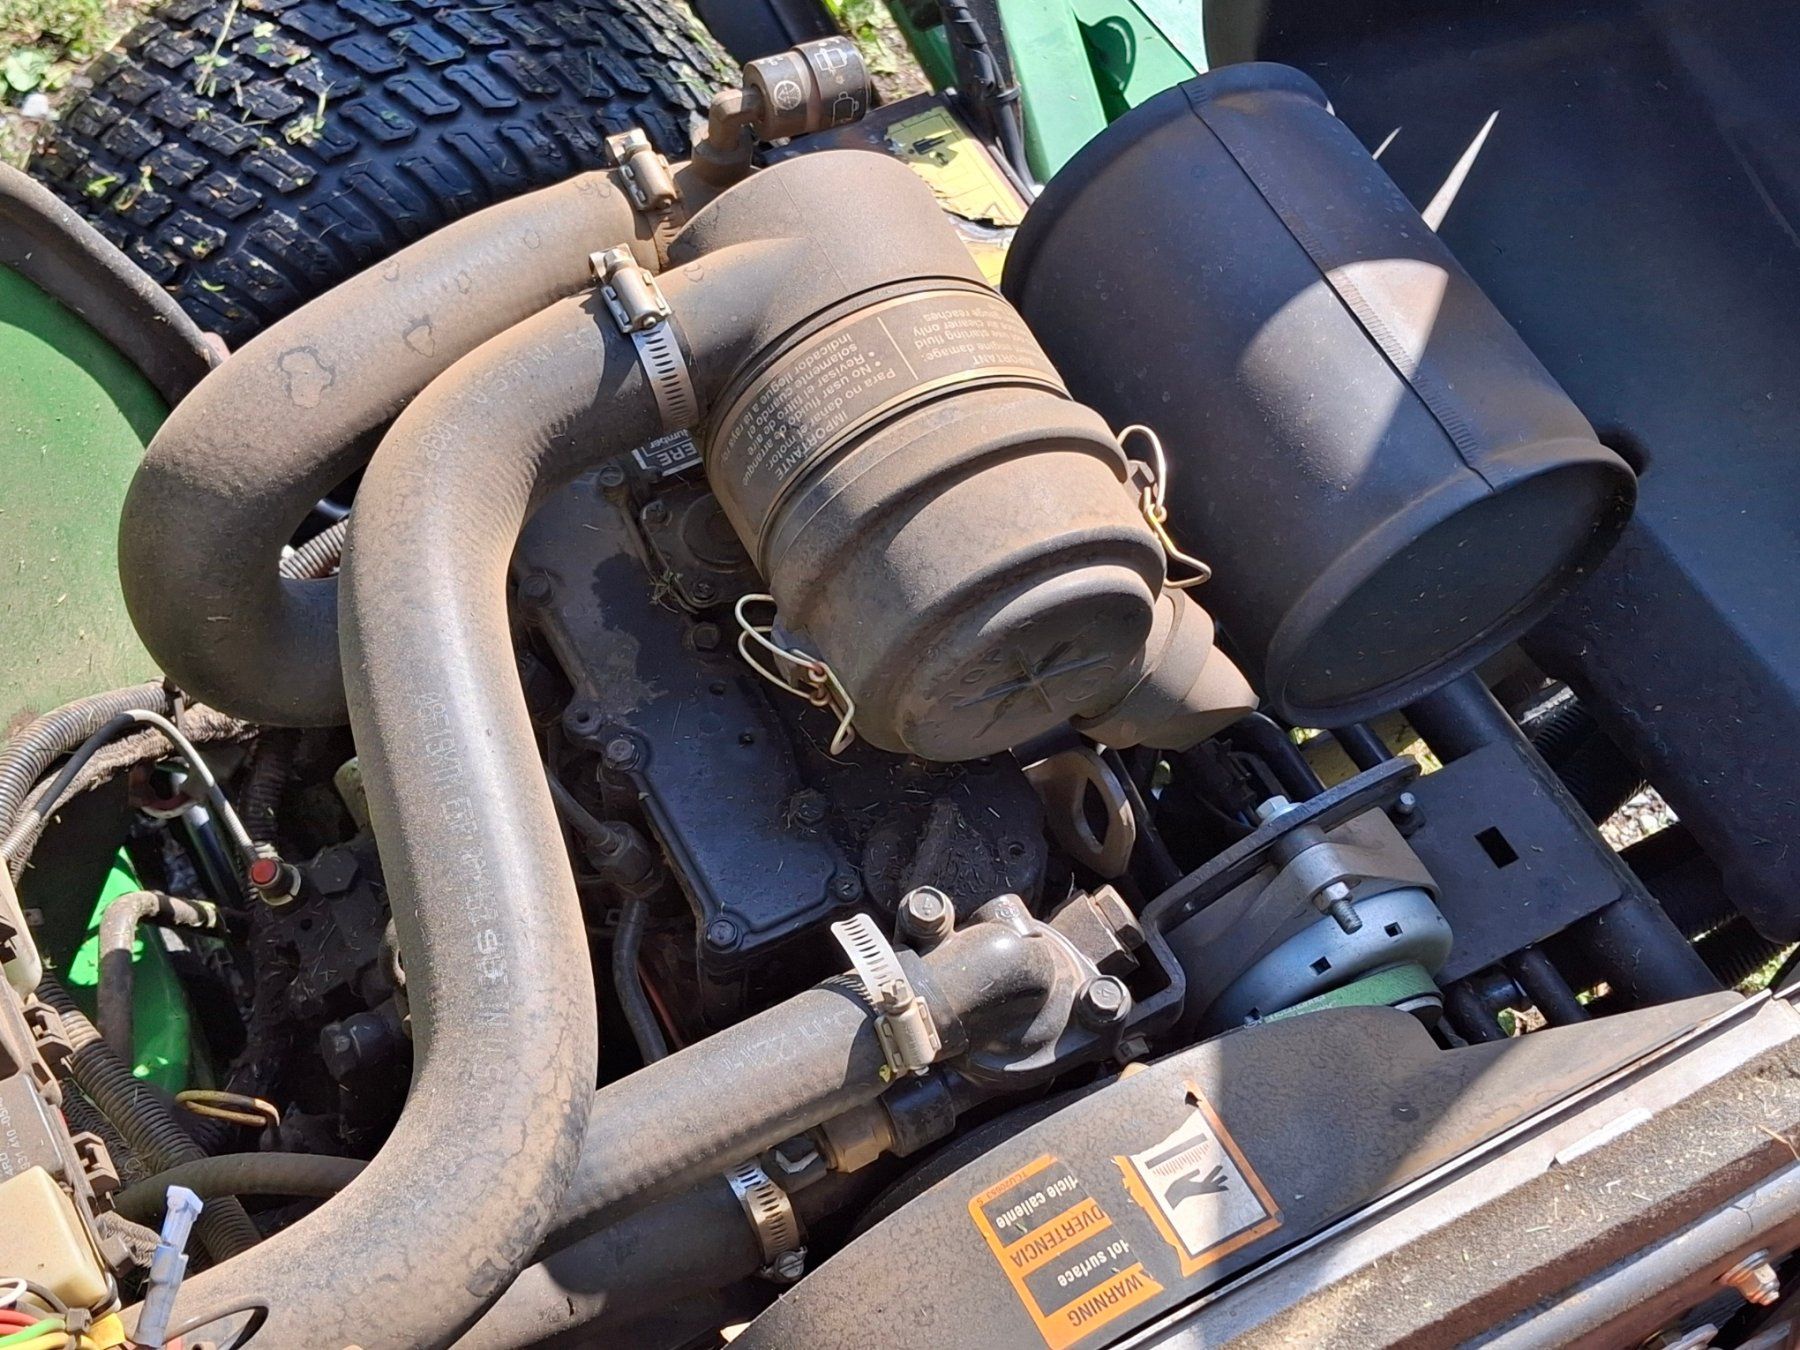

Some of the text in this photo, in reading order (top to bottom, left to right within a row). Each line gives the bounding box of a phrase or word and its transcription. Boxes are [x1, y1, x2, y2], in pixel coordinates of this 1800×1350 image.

[913, 324, 939, 337] only
[915, 335, 944, 350] fluid
[792, 333, 852, 375] indicador
[793, 343, 858, 388] solamente
[851, 364, 872, 379] No
[759, 372, 794, 405] llegue
[821, 375, 850, 399] usar
[844, 385, 863, 399] no
[864, 367, 897, 387] Para
[746, 354, 865, 456] Revisar el filtro de aire
[754, 386, 795, 427] cuando
[786, 396, 822, 428] fluido
[741, 438, 775, 485] arranque
[764, 435, 797, 470] motor:
[772, 410, 849, 480] IMPORTANTE
[994, 1191, 1048, 1231] caliente
[1056, 1250, 1109, 1289] surface
[1066, 1273, 1143, 1328] WARNING
